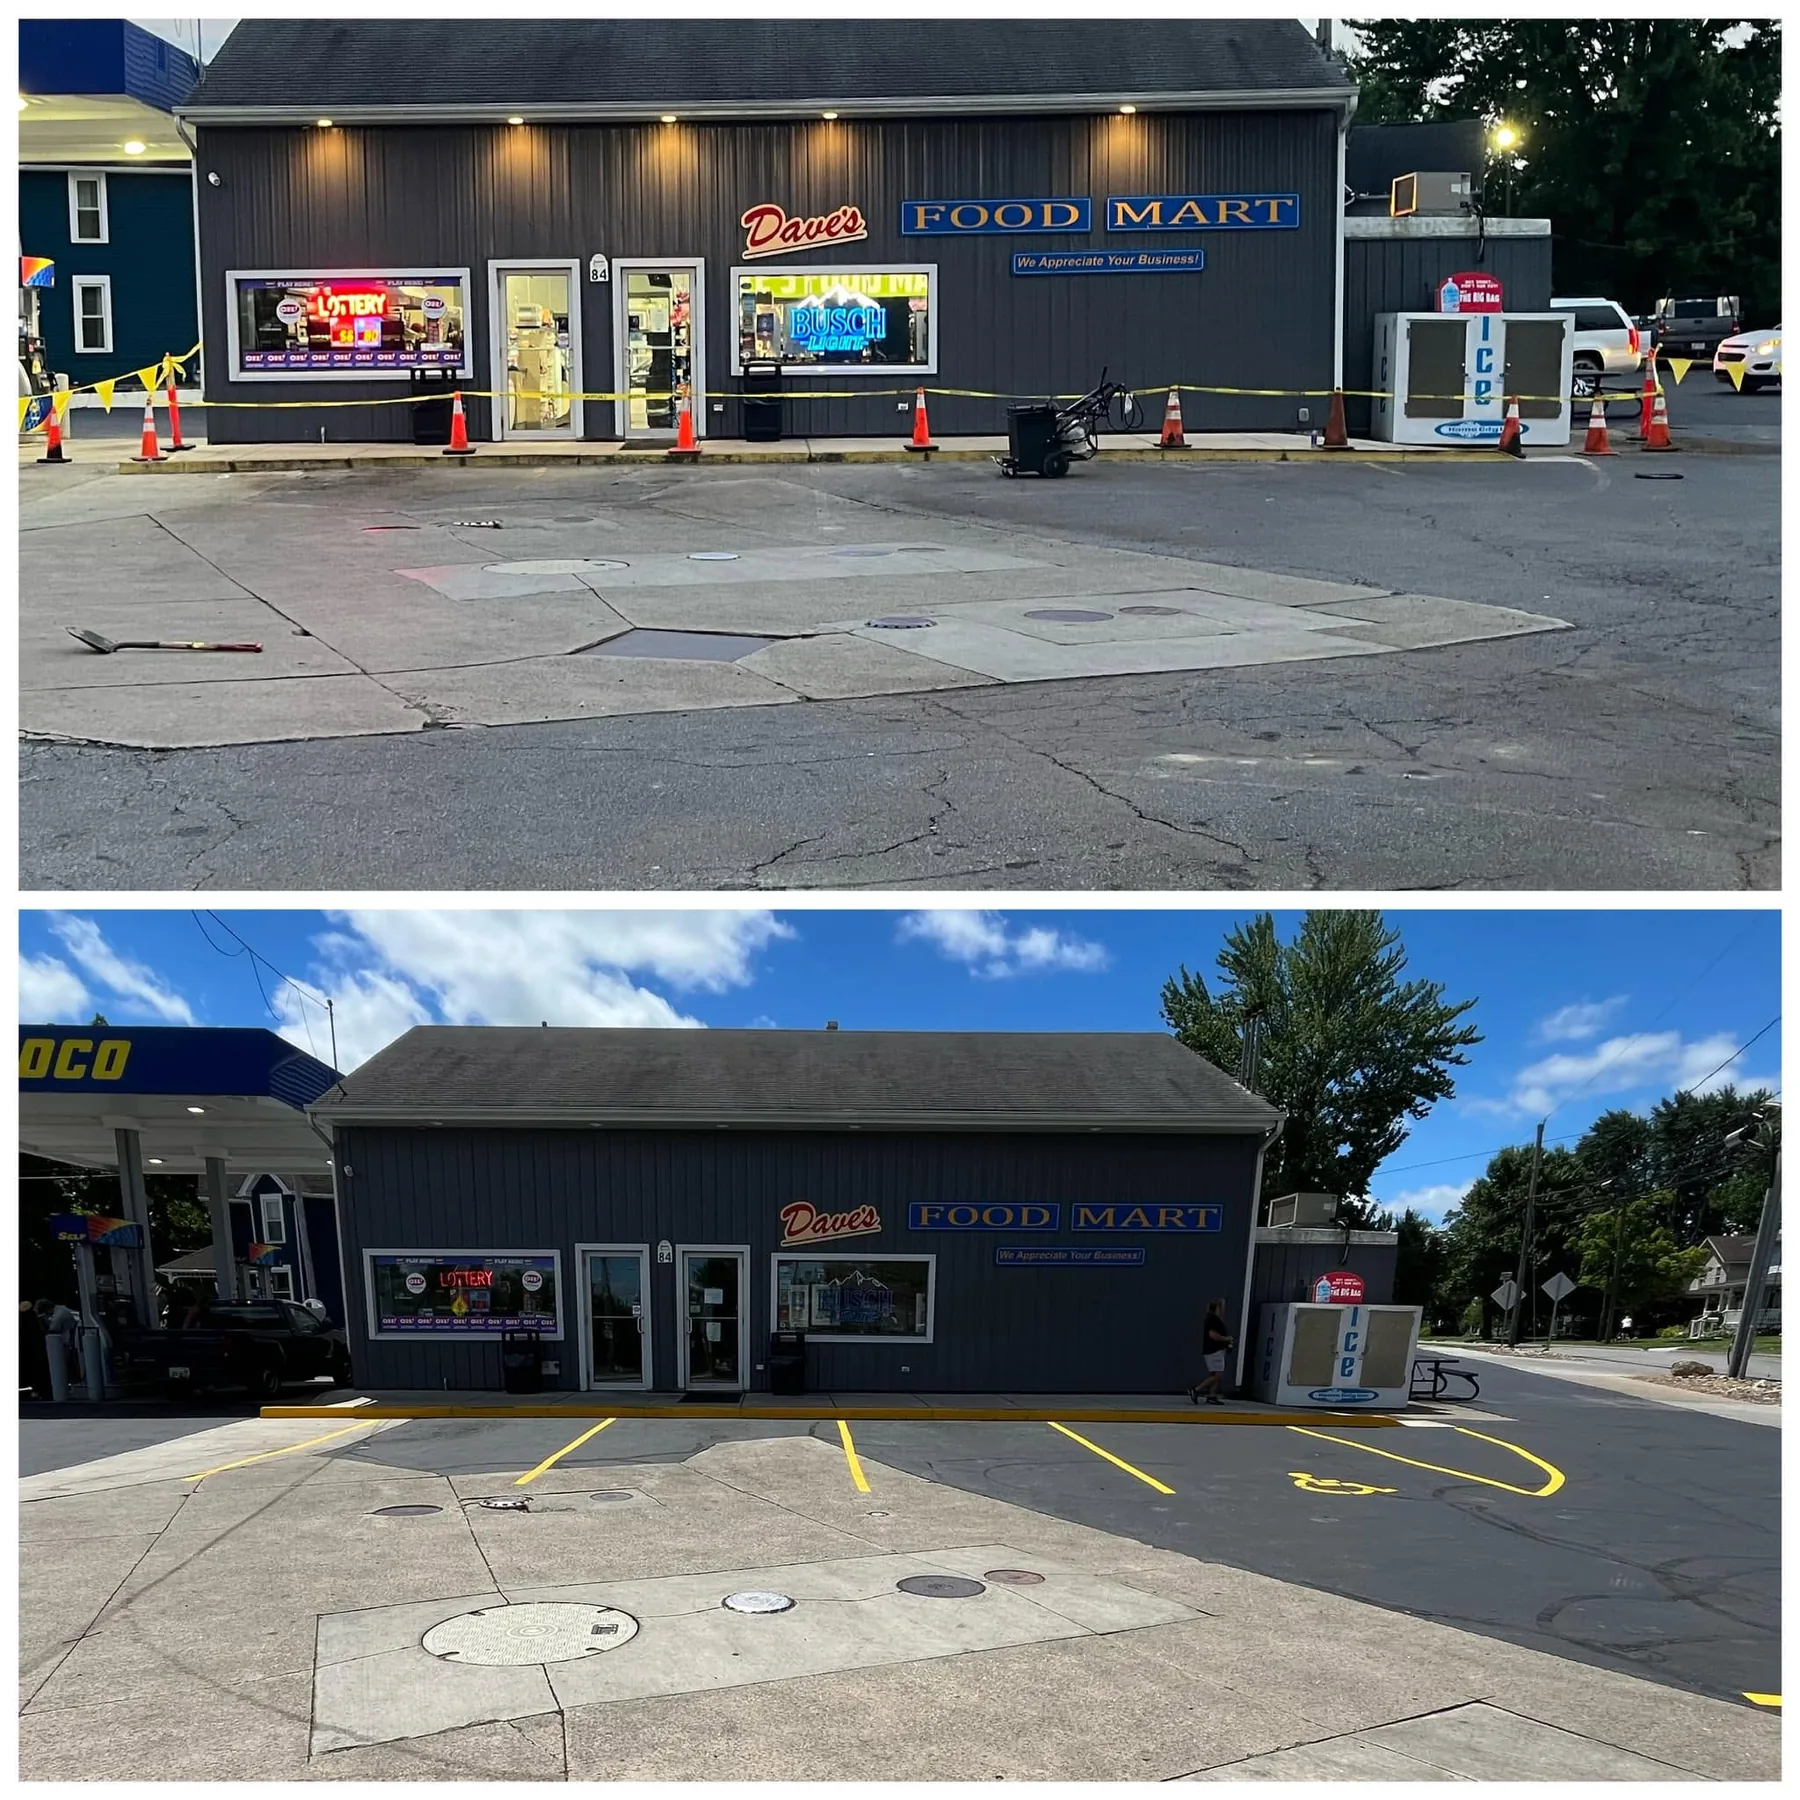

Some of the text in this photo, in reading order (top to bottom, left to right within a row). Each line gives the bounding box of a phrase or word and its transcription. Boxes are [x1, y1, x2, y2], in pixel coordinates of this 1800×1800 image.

[914, 199, 1294, 229] FOOD MART
[743, 205, 864, 247] Dave's
[1017, 253, 1200, 269] We Appreciate Your Business!
[591, 268, 607, 281] 84
[317, 293, 386, 317] LOTTERY
[790, 307, 887, 339] BUSCH
[19, 1038, 132, 1081] OCO
[782, 1203, 879, 1238] Dave's
[919, 1206, 1218, 1228] FOOD MART
[659, 1252, 671, 1262] 84
[999, 1250, 1142, 1261] We Appreciate Your Business!
[440, 1271, 493, 1287] LOTTERY
